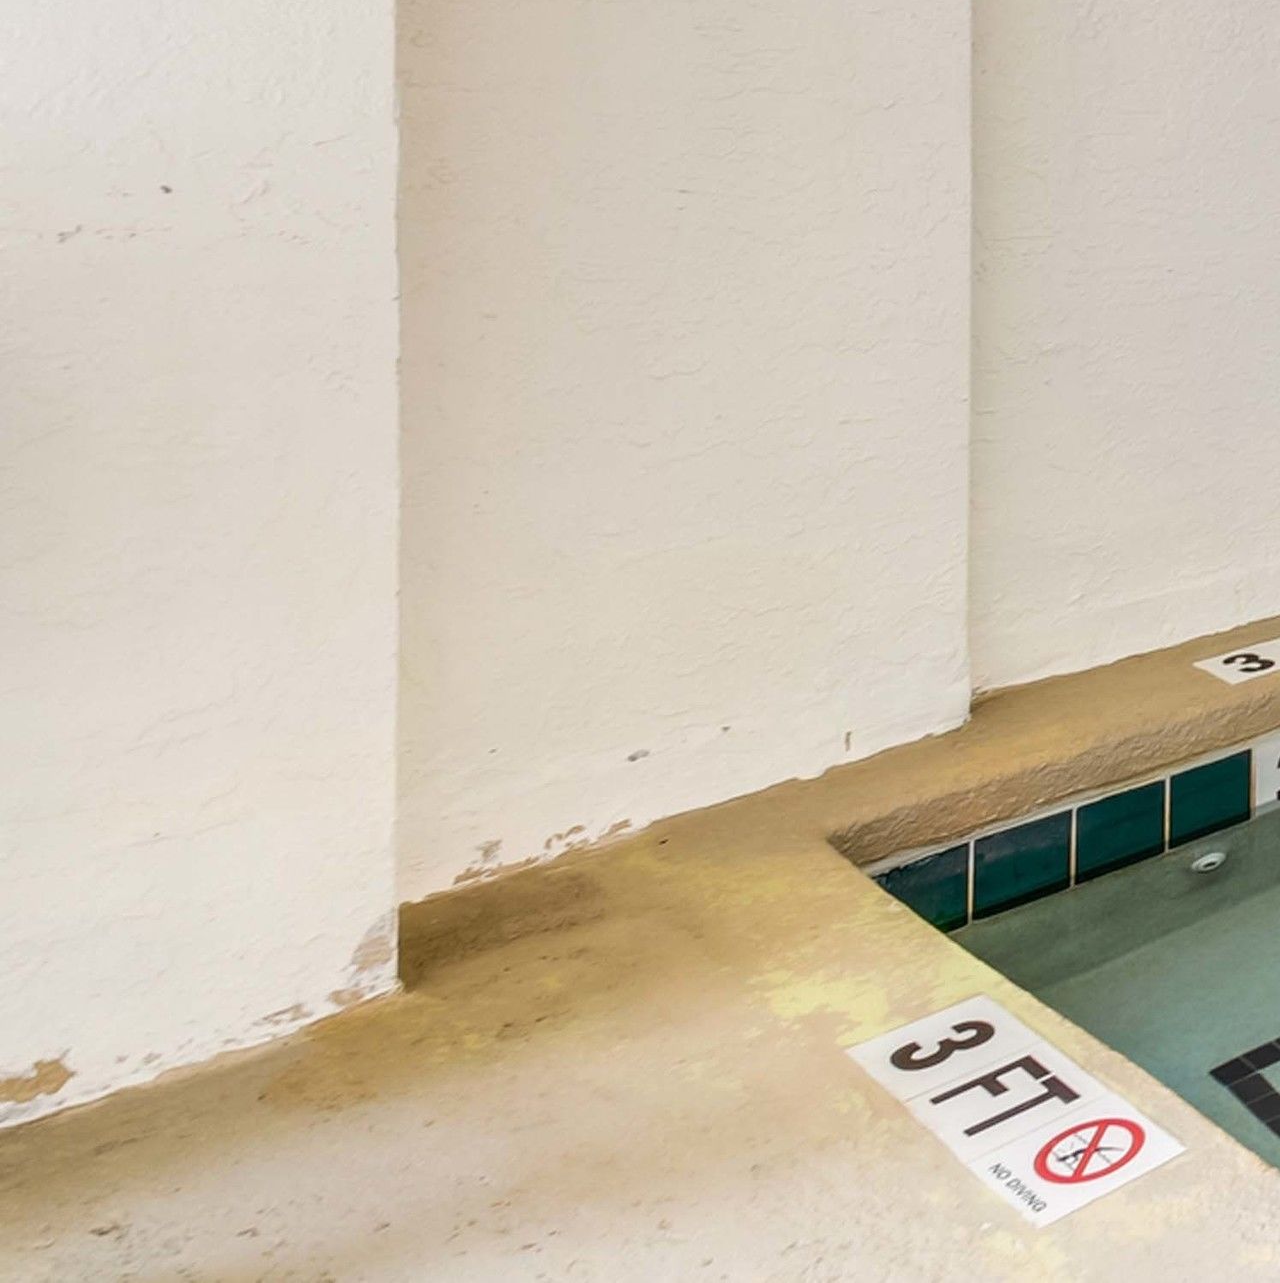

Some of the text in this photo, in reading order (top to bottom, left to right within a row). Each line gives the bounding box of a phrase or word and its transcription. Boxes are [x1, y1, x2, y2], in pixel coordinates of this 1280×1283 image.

[1223, 653, 1276, 673] 3
[889, 1020, 1081, 1137] 3 FT
[988, 1163, 1047, 1213] NO DIVING
